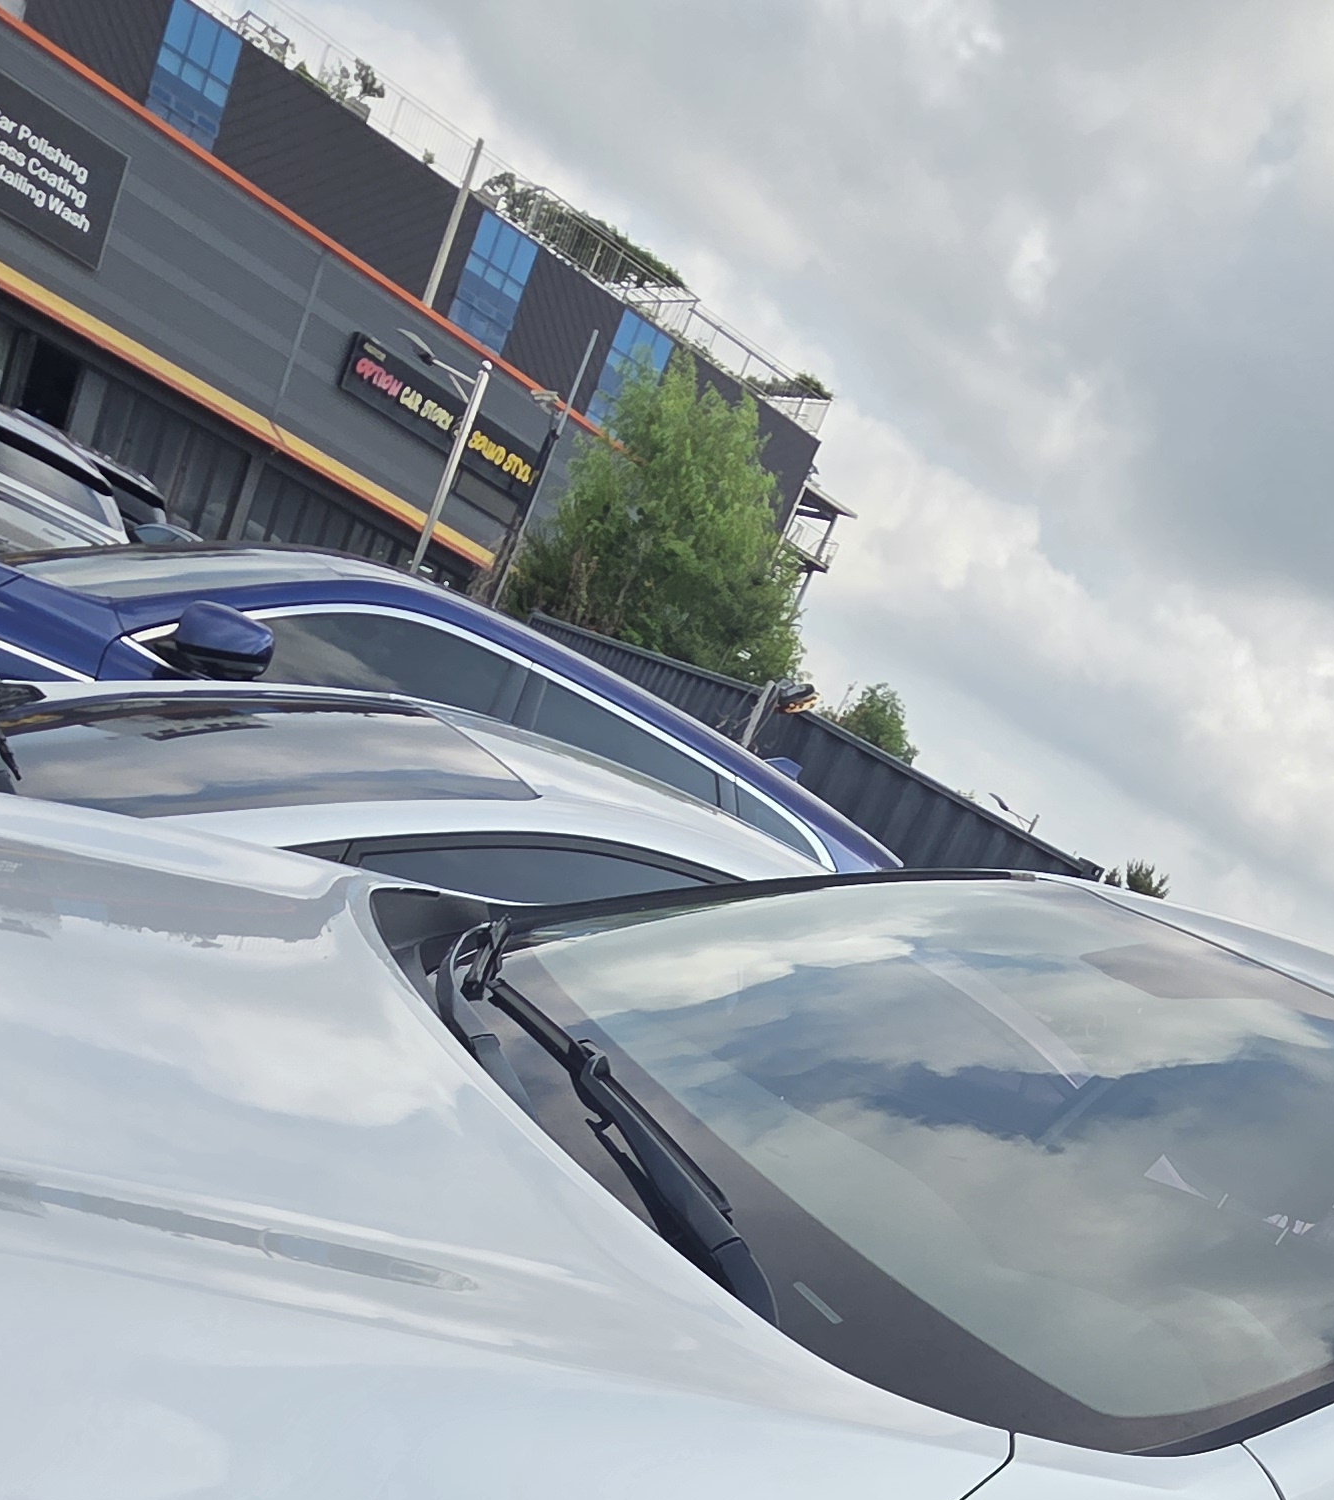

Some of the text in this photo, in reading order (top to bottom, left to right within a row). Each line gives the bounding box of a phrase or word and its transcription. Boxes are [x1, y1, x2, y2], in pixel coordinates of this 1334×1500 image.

[17, 124, 89, 185] Polishing
[27, 157, 88, 209] Coating
[48, 194, 91, 233] Wash
[356, 357, 403, 397] OPTION
[399, 386, 423, 412] CAR
[468, 430, 507, 466] SOUND
